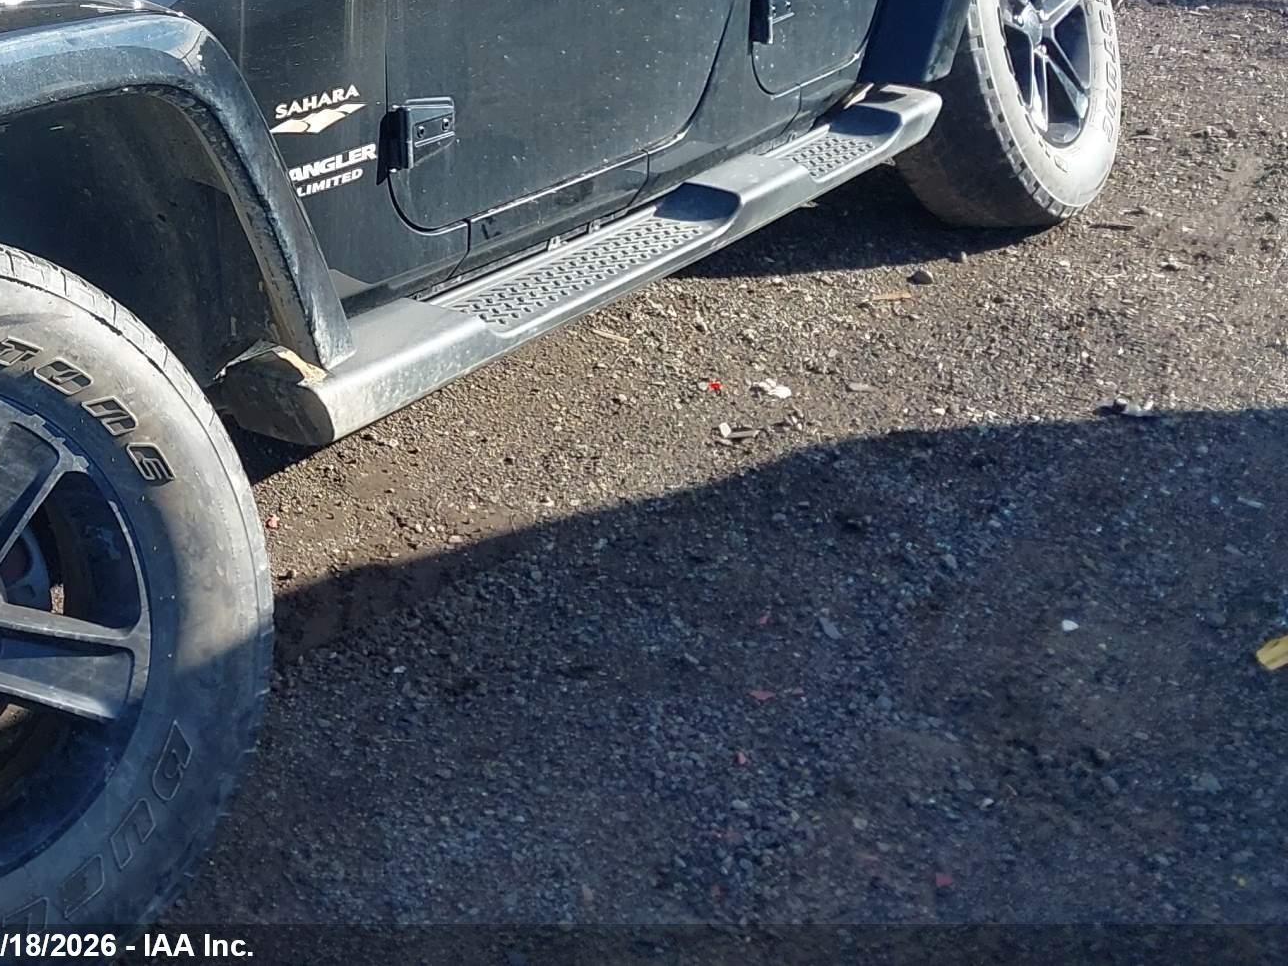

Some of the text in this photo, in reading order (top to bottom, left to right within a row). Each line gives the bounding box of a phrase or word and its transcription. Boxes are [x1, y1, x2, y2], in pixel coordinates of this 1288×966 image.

[275, 84, 360, 119] SAHARA
[288, 143, 378, 182] ANGLER
[296, 168, 364, 198] LIMITED
